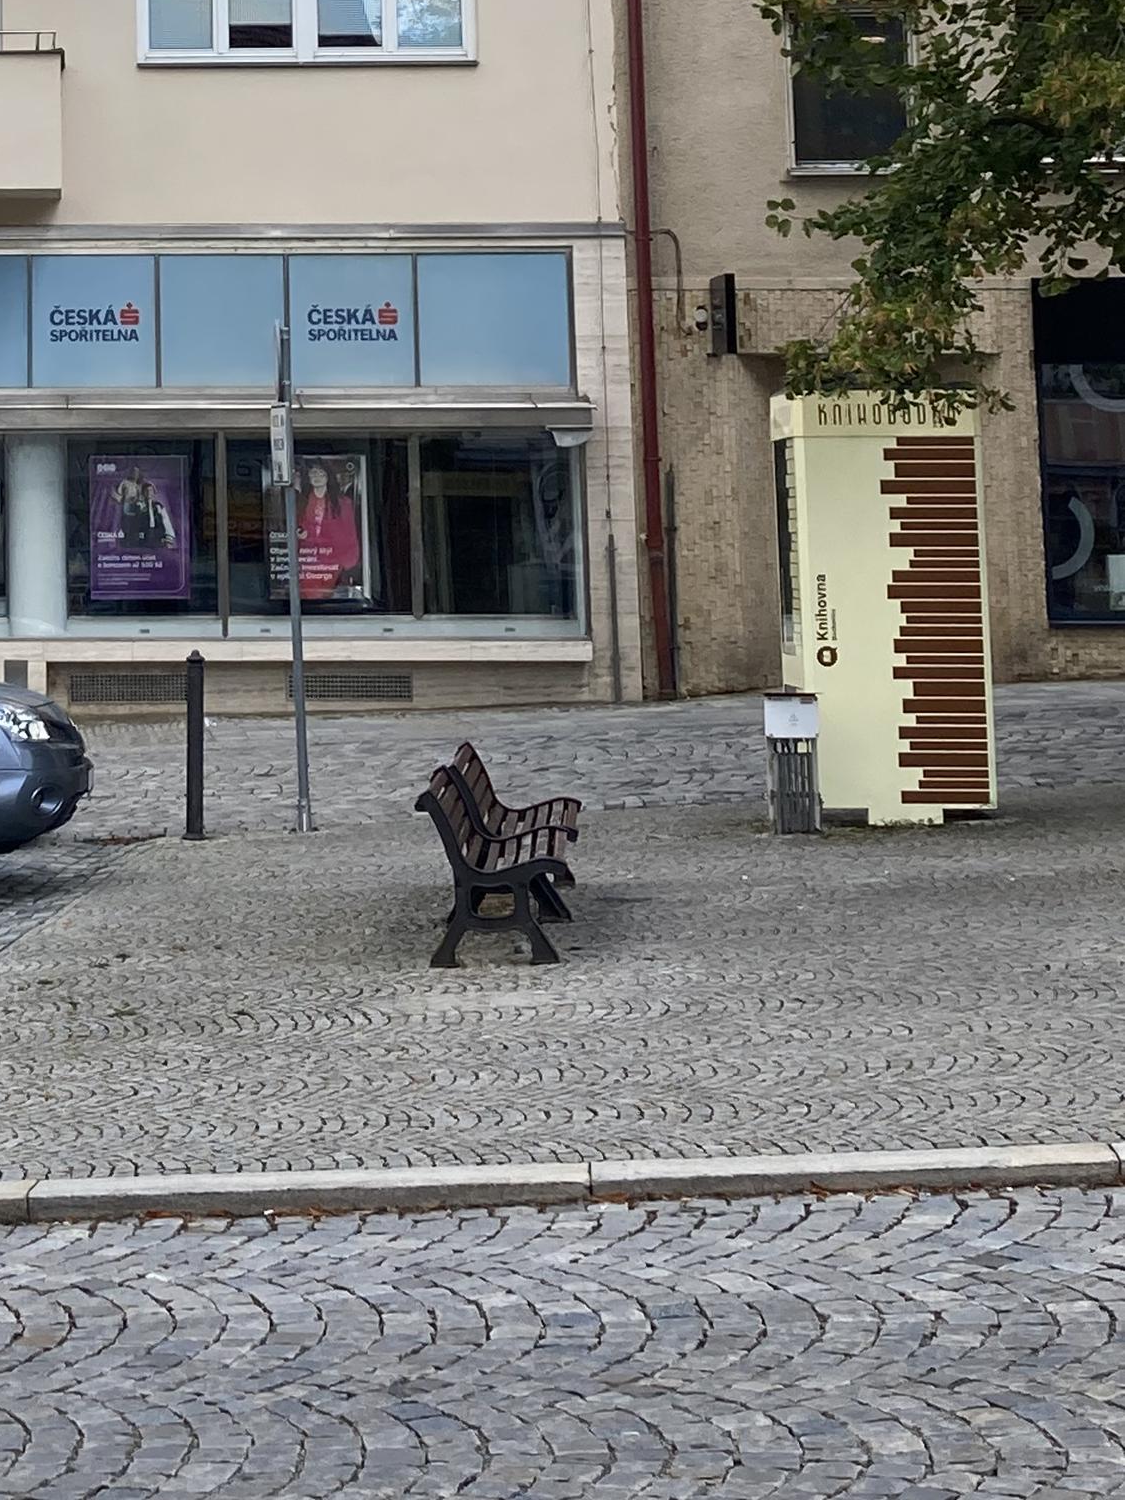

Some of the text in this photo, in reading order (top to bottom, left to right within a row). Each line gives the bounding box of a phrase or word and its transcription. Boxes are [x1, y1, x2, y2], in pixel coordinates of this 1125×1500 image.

[49, 304, 118, 326] ČESKÁ
[307, 304, 376, 325] ČESKÁ
[49, 326, 139, 342] SPOŘITELNA
[307, 326, 398, 342] SPOŘITELNA
[815, 574, 828, 641] Knihovna
